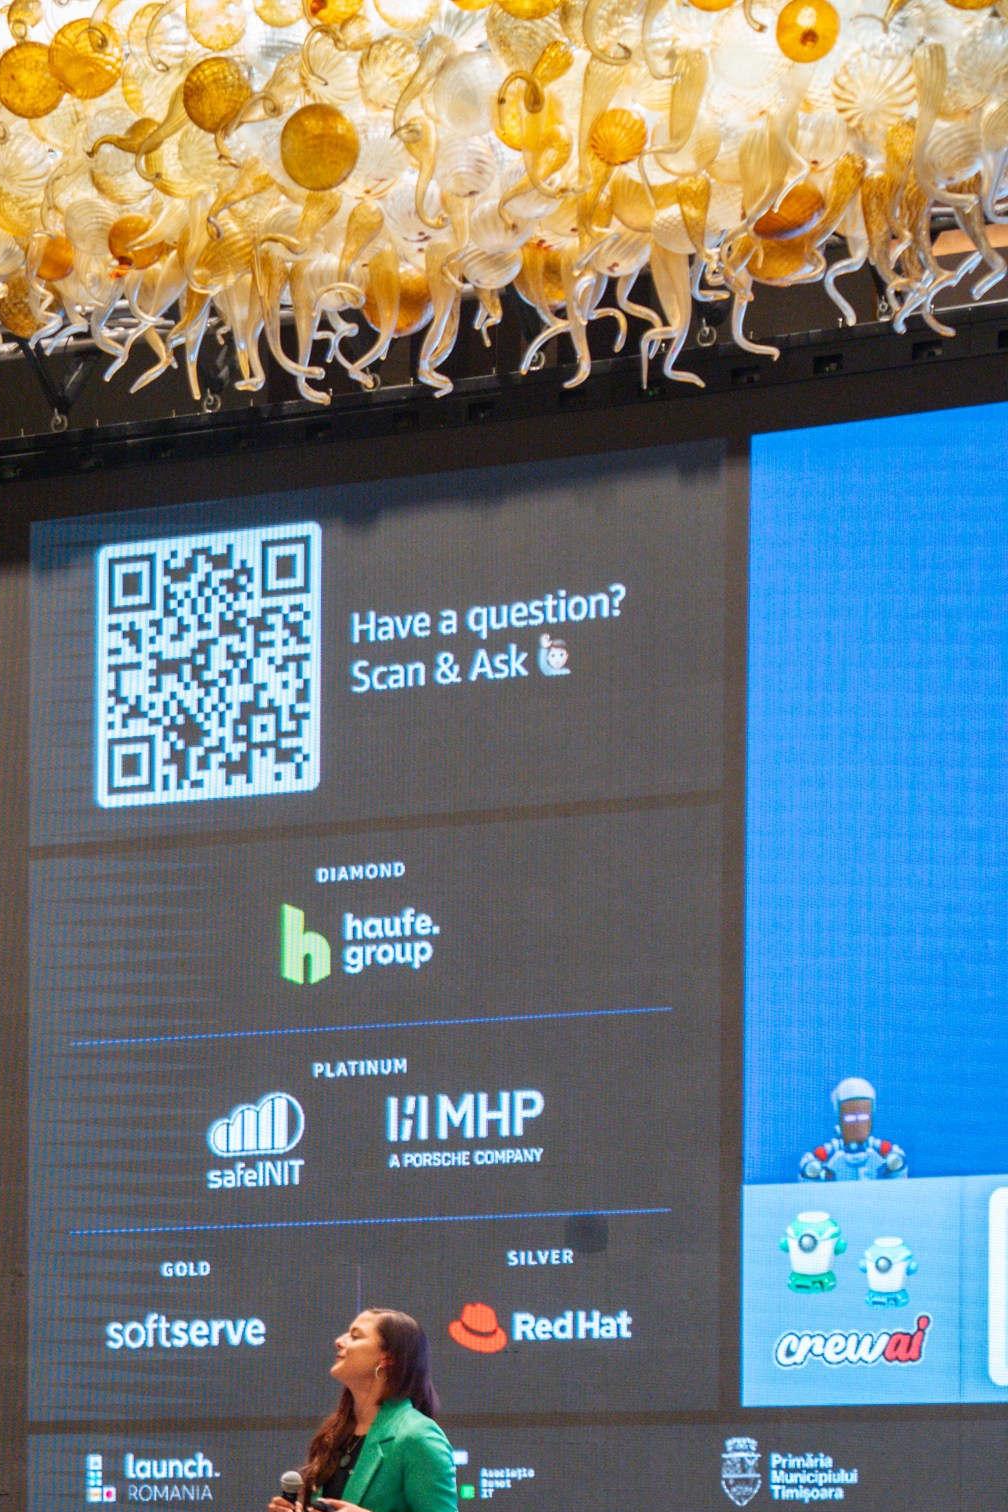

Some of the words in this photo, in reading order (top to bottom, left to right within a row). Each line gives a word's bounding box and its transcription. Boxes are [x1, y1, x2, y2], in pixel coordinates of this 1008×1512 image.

[350, 610, 431, 644] Have
[437, 608, 458, 636] a
[465, 582, 626, 640] question?
[350, 659, 426, 693] Scan
[433, 651, 462, 685] &
[467, 643, 529, 682] Ask
[315, 861, 406, 883] DIAMOND
[343, 907, 440, 941] haufe.
[343, 940, 434, 974] group
[311, 1057, 408, 1078] PLATINUM
[436, 1089, 545, 1140] MHP
[388, 1154, 400, 1168] A
[402, 1151, 471, 1168] PORSCHE
[472, 1147, 544, 1166] COMPANY
[206, 1158, 305, 1189] safeINIT
[160, 1260, 211, 1278] GOLD
[506, 1248, 574, 1266] SILVER
[105, 1312, 267, 1349] softserve
[775, 1314, 931, 1367] crewai
[769, 1452, 834, 1469] Primăria
[769, 1468, 859, 1486] Municipiului
[128, 1484, 213, 1502] ROMANIA
